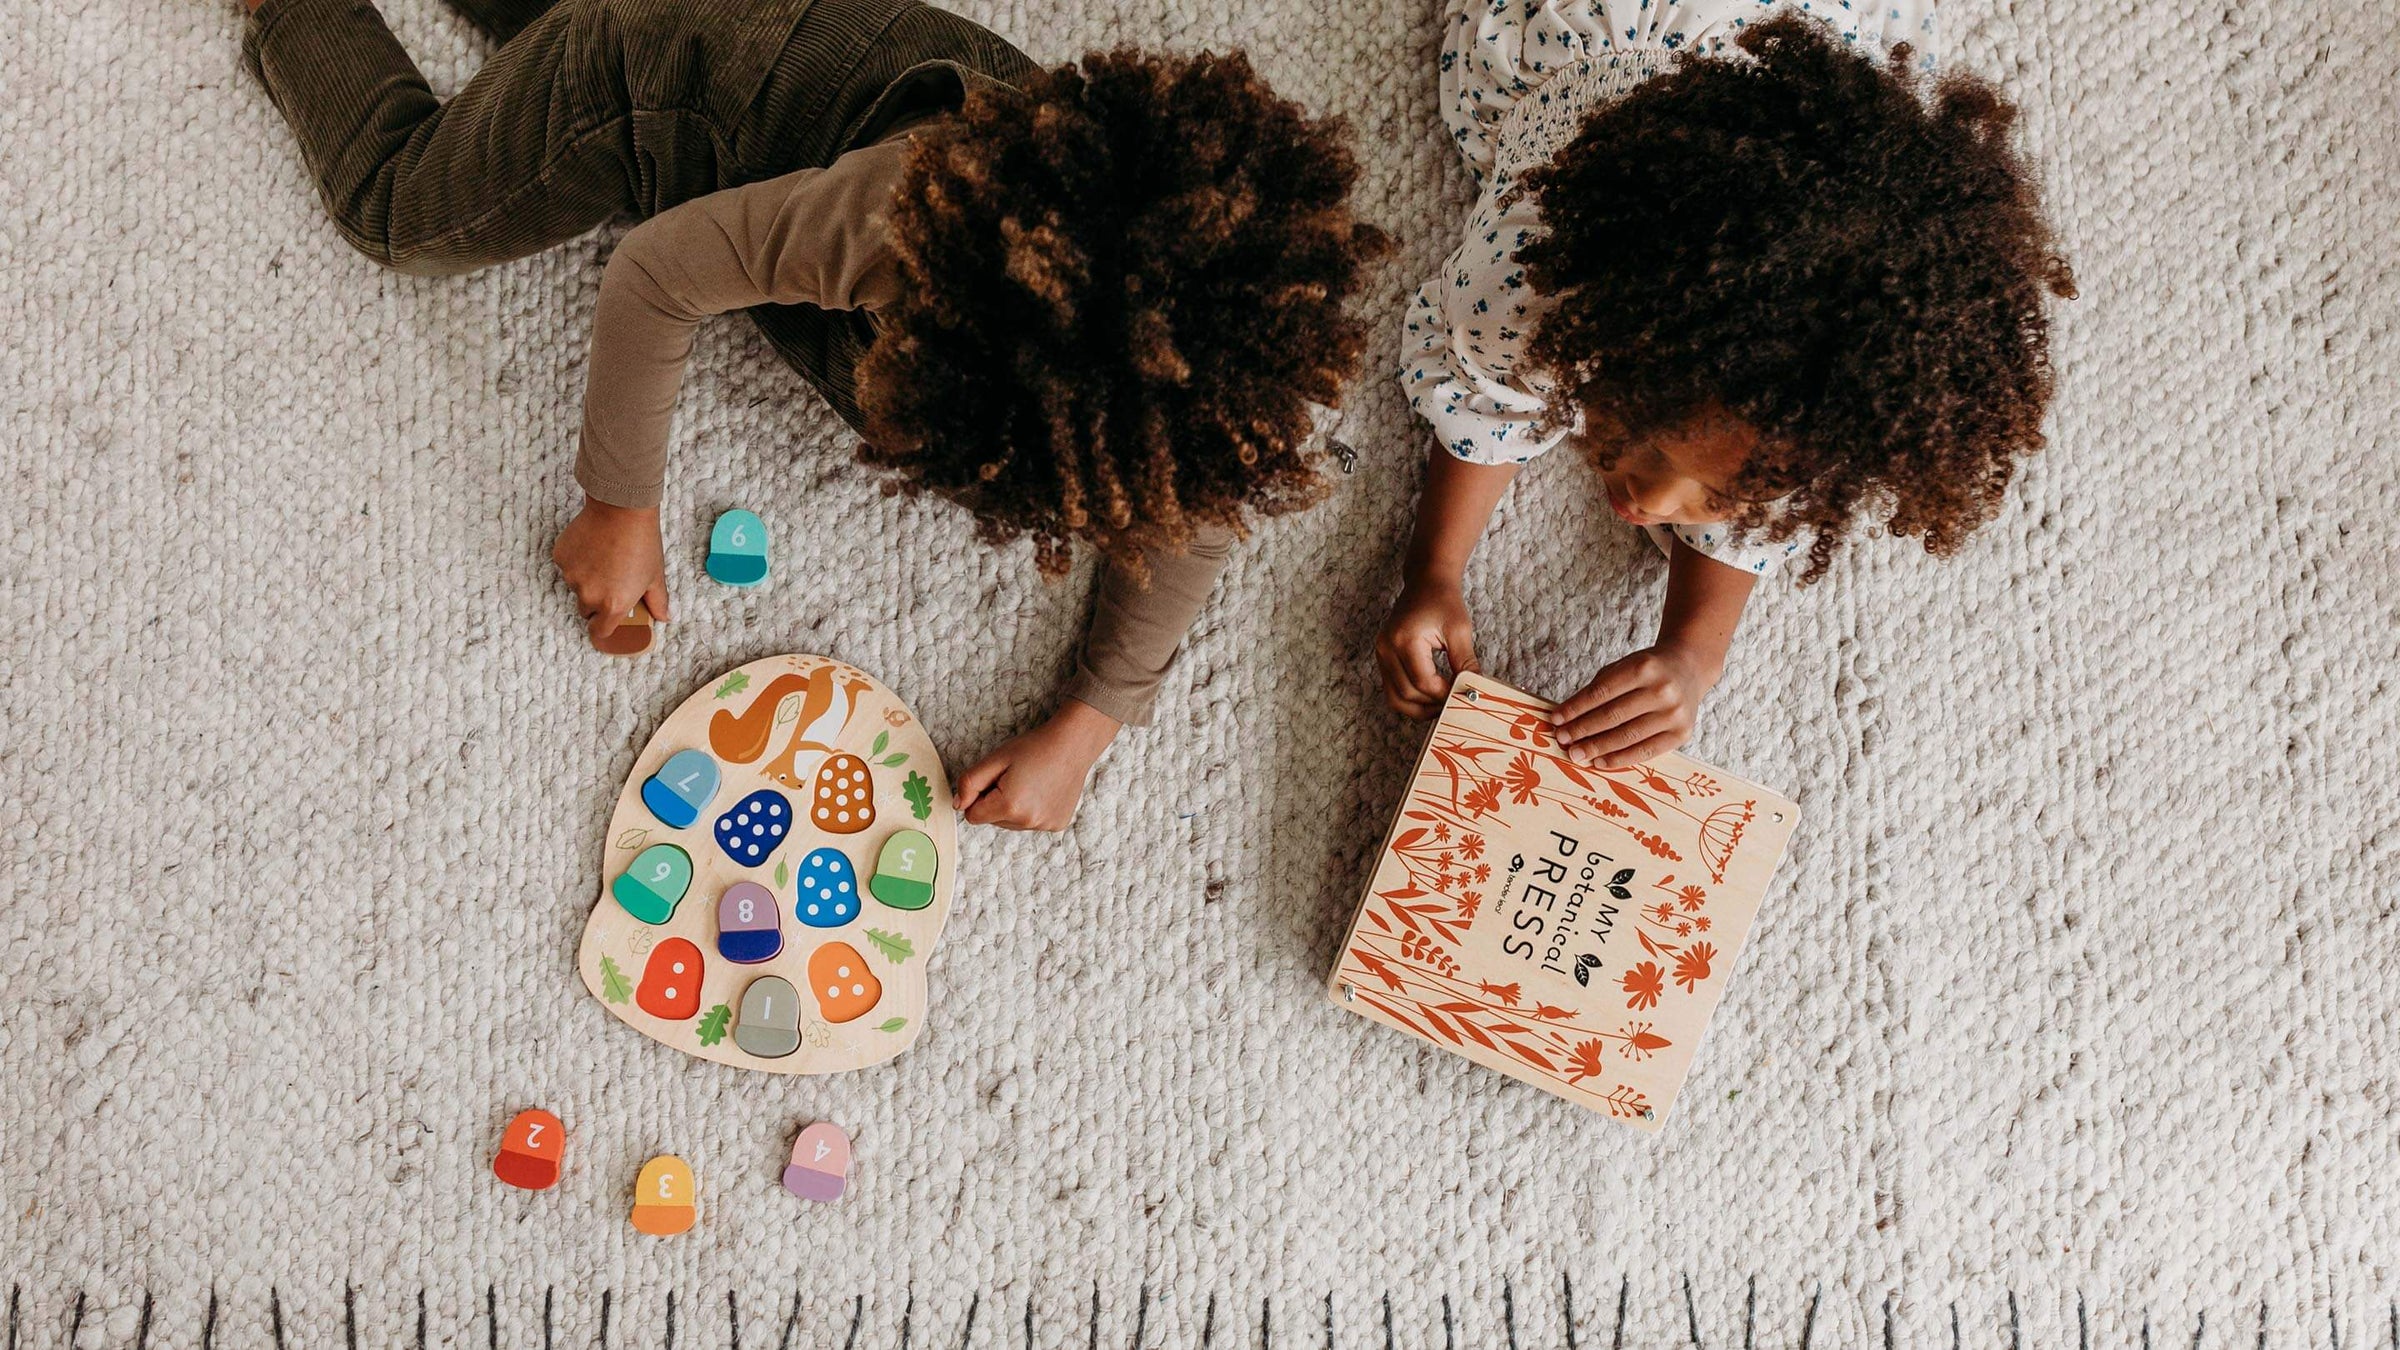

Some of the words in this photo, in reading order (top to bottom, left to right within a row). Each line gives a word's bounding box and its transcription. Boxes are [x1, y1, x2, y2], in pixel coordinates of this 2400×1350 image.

[677, 771, 701, 793] 7
[900, 848, 917, 872] 5
[1503, 830, 1579, 961] PRESS
[738, 898, 754, 923] 8
[1541, 851, 1614, 975] botanical
[1590, 903, 1620, 944] MY
[763, 996, 772, 1021] 1
[527, 1123, 546, 1149] 2
[814, 1139, 832, 1163] 4
[658, 1173, 674, 1199] 3
